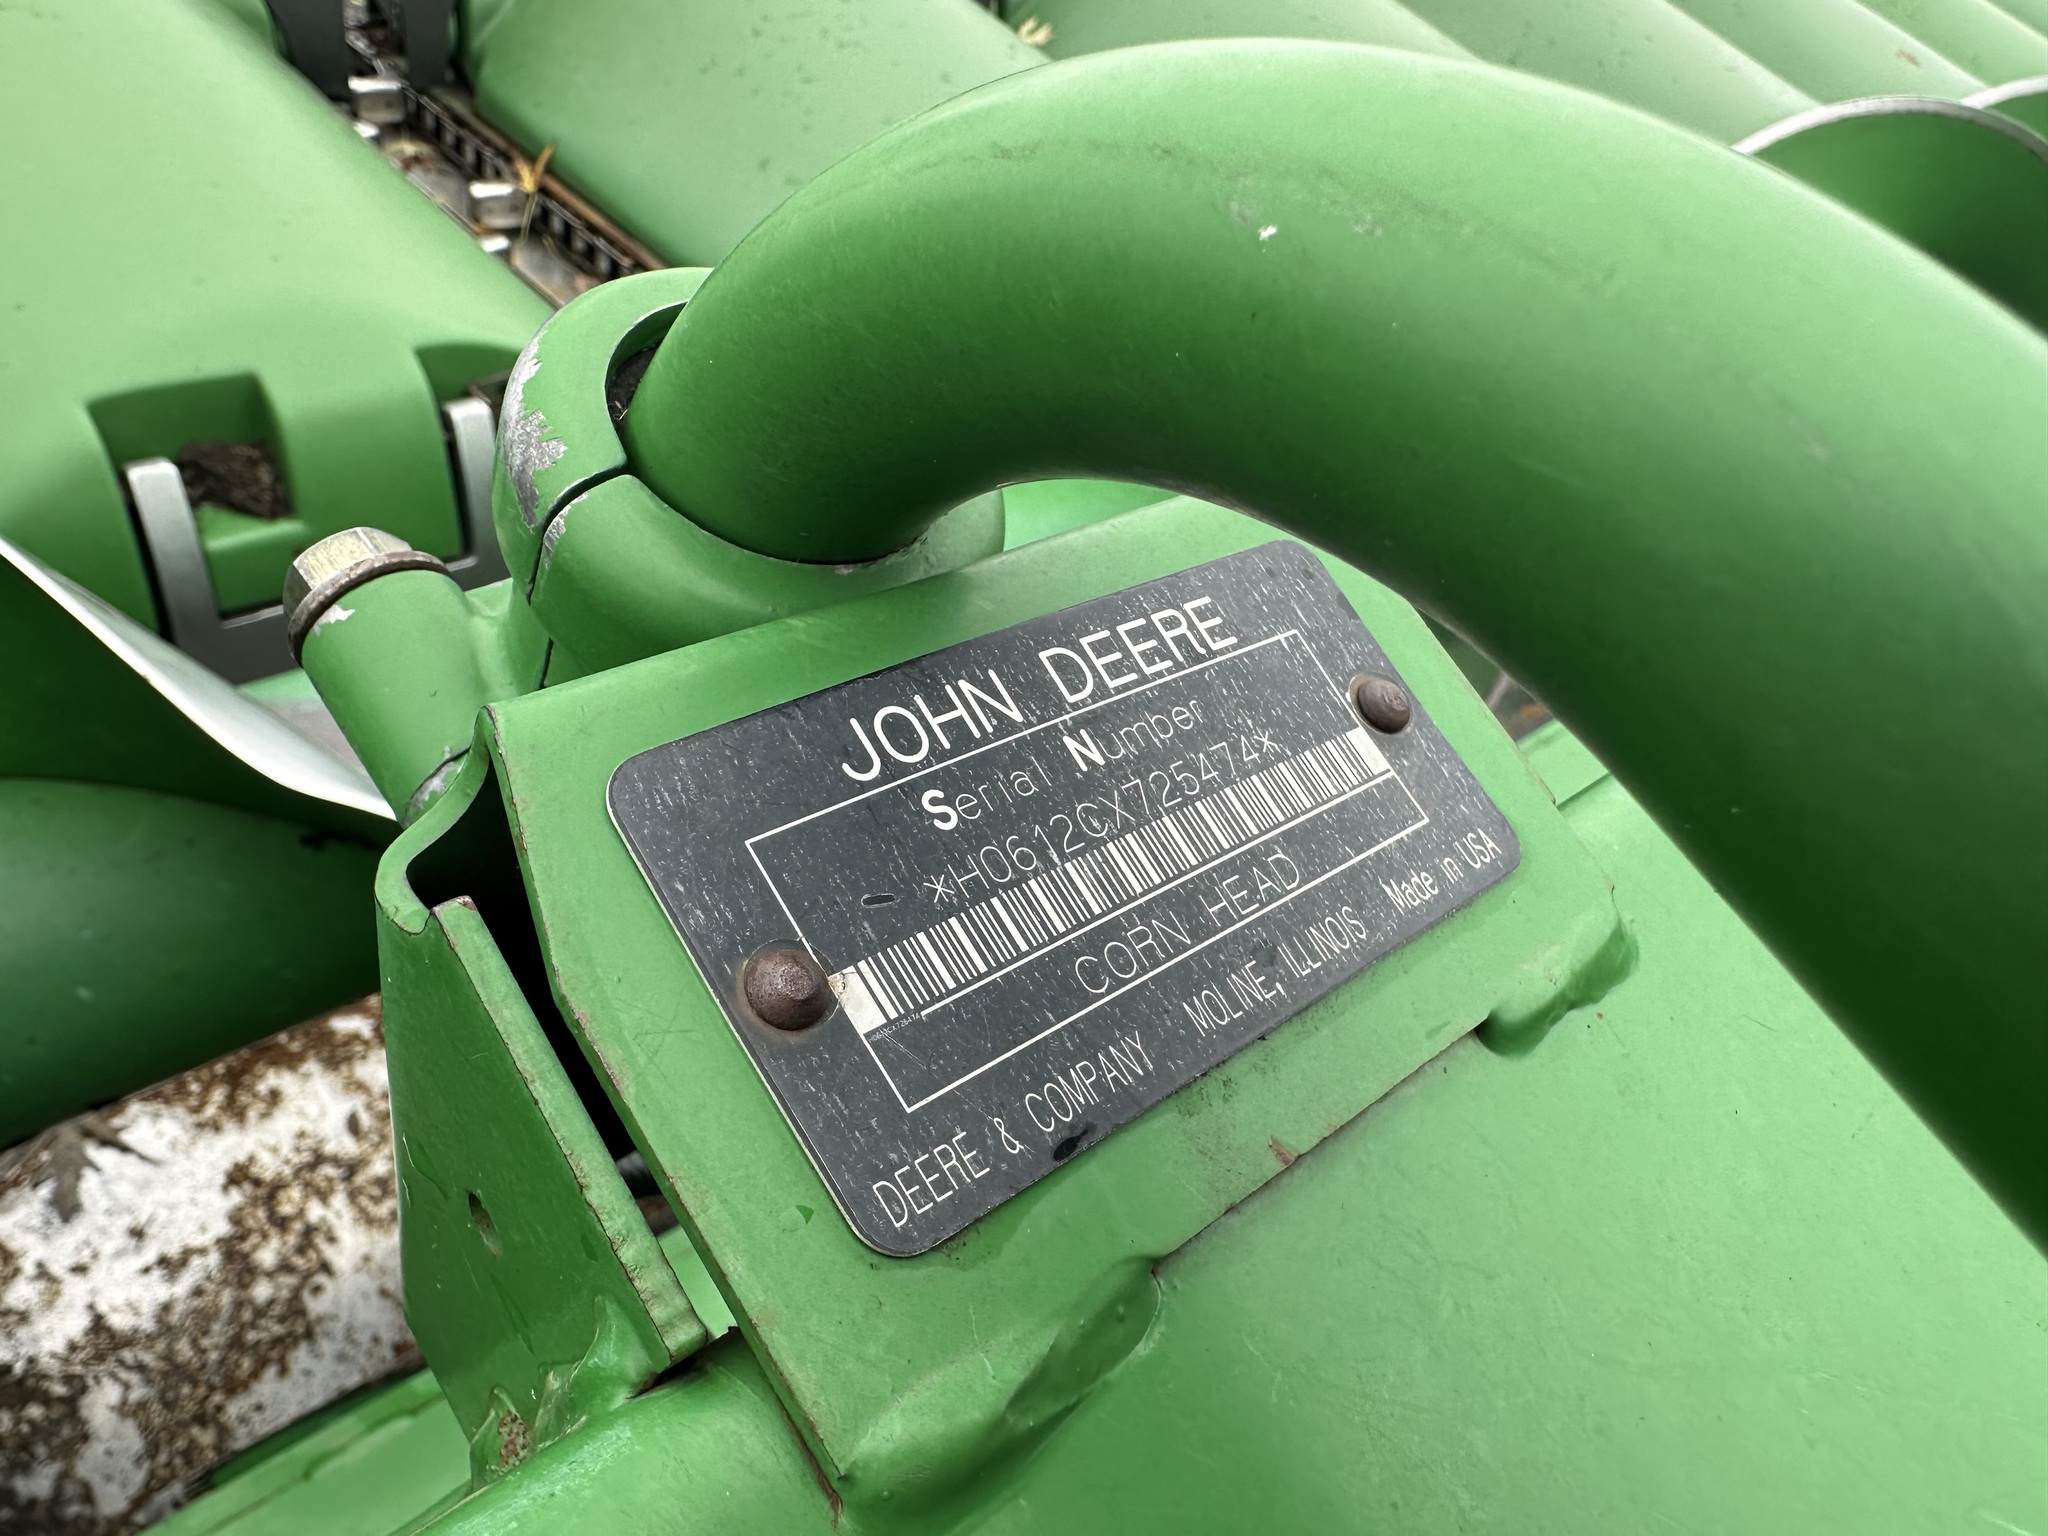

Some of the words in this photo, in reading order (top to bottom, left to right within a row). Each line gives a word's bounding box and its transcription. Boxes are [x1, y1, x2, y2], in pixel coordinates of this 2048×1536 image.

[842, 669, 1024, 781] JOHN
[1038, 595, 1237, 702] DEERE
[921, 756, 1052, 830] Serial
[1062, 700, 1203, 771] Number
[1075, 911, 1191, 994] CORN
[1199, 853, 1300, 927] HEAD
[872, 1131, 990, 1228] DEERE
[993, 1117, 1024, 1153] &
[1025, 1030, 1154, 1132] COMPANY
[1182, 960, 1286, 1036] MOLINE,
[1276, 906, 1367, 978] ILLINOIS
[1381, 871, 1439, 915] Made
[1442, 857, 1464, 884] in
[1455, 827, 1502, 869] USA
